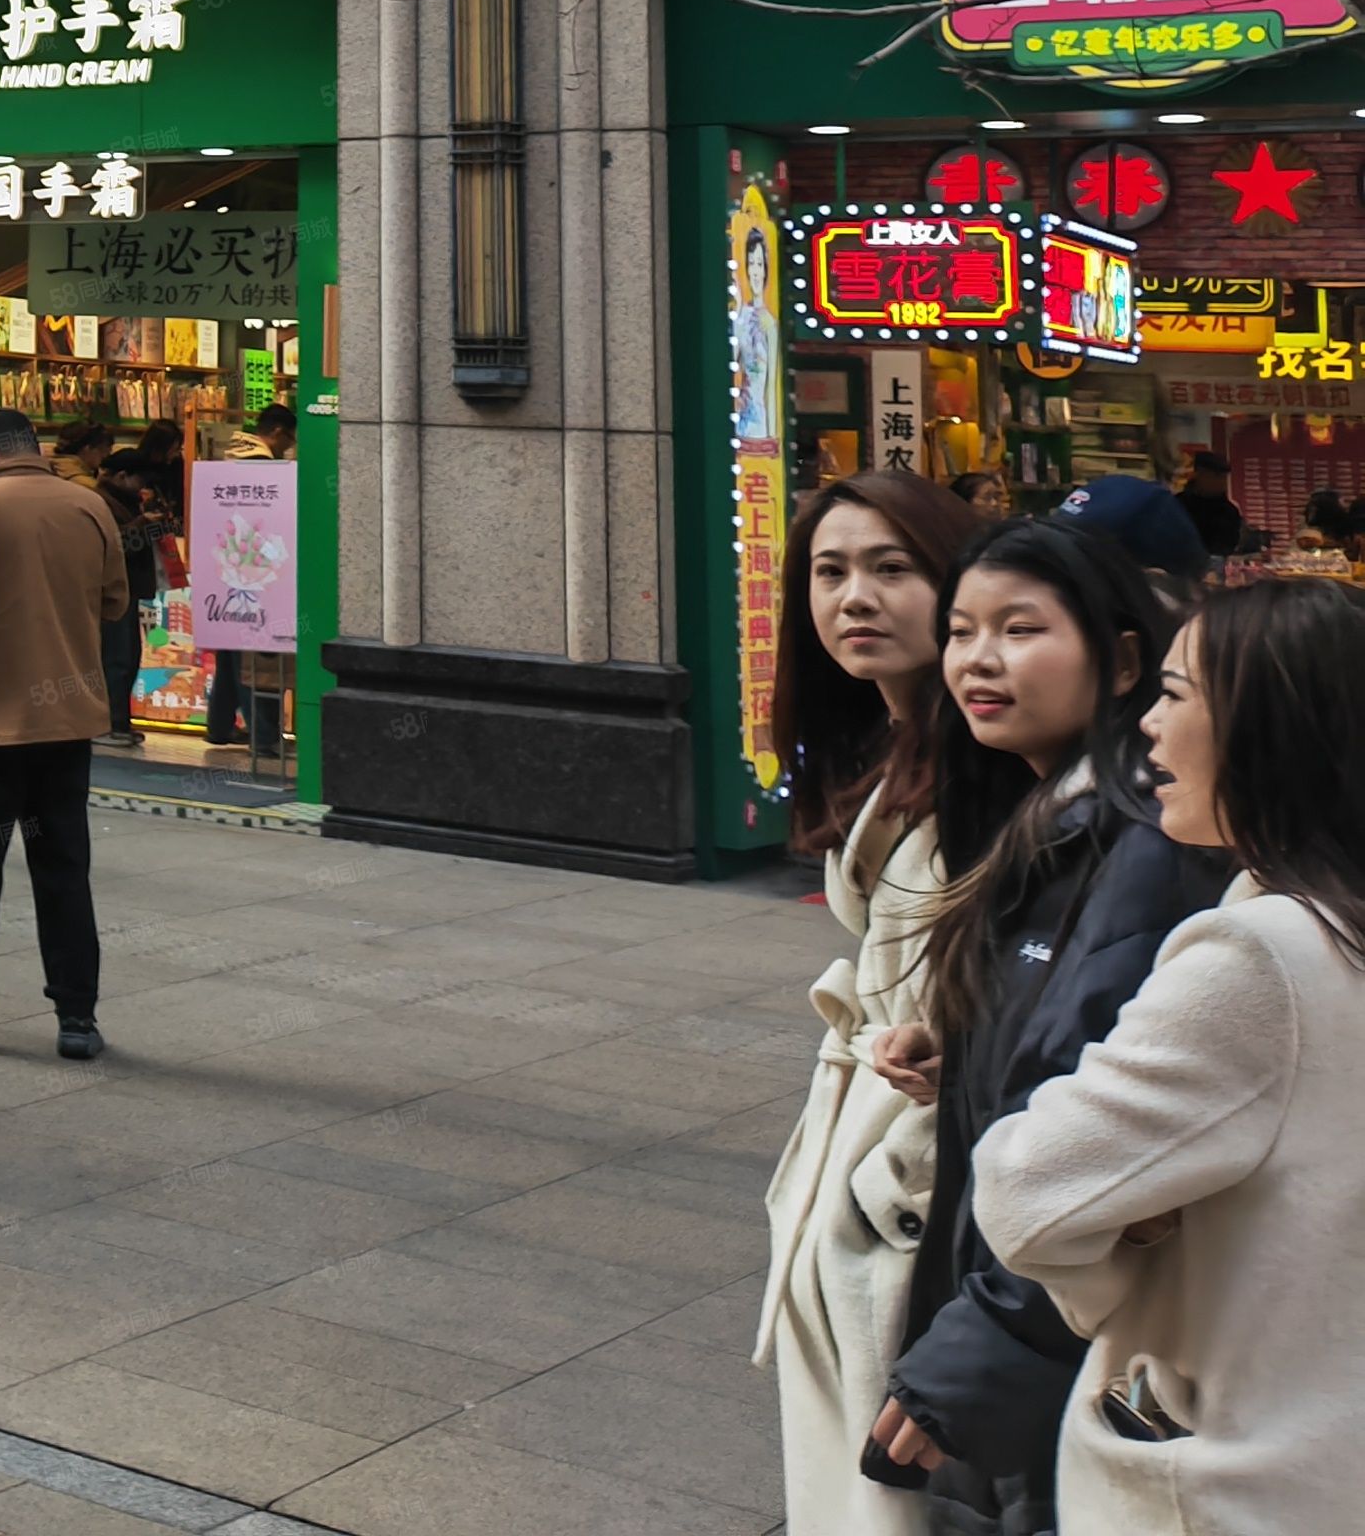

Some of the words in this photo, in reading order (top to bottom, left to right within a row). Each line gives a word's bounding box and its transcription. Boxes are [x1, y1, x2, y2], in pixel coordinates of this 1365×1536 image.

[1051, 20, 1244, 59] 忆童年欢乐多
[0, 63, 67, 89] HAND
[65, 57, 153, 86] CREAM
[866, 221, 959, 246] 上海女人
[832, 250, 1003, 304] 雪花膏
[1257, 338, 1365, 381] 找名
[212, 483, 279, 500] 女神节快乐
